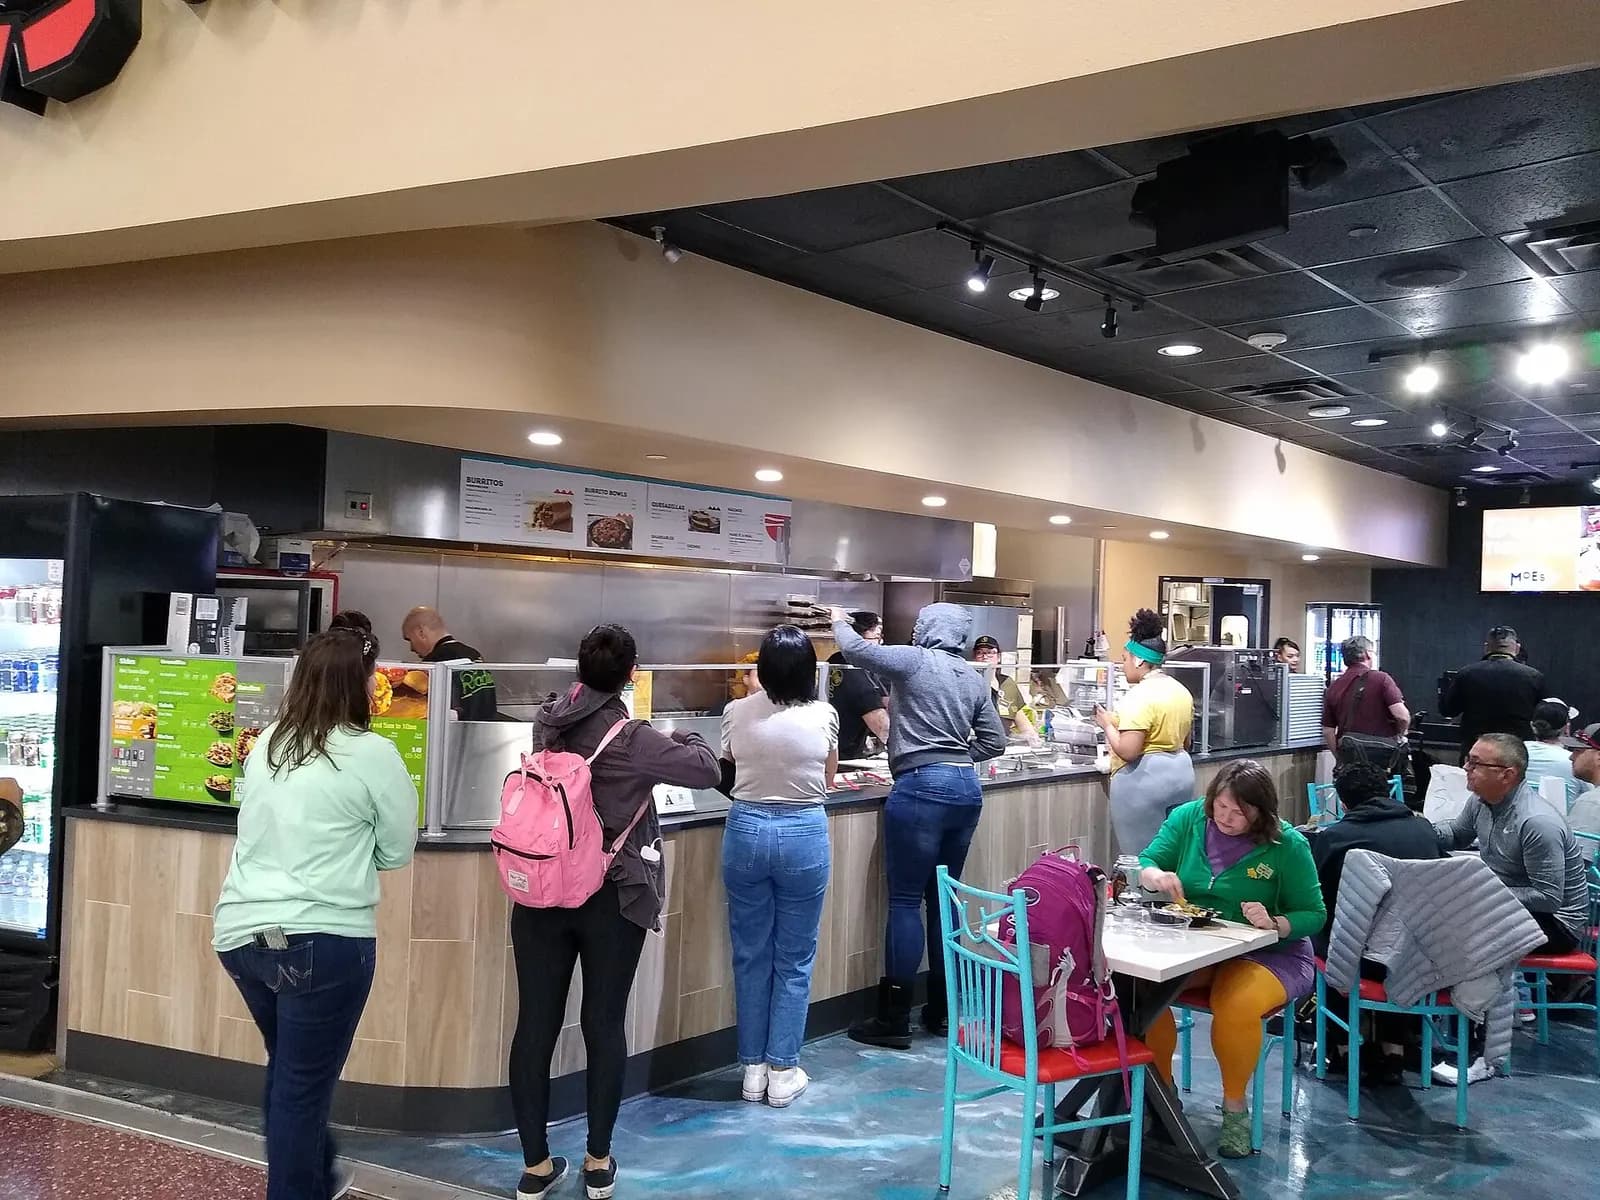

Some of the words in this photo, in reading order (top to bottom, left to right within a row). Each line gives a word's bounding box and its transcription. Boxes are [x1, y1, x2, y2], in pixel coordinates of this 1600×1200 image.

[466, 476, 504, 487] BURRITOS
[609, 489, 627, 497] BOWLS
[651, 501, 685, 510] QUESADILLAS
[665, 794, 674, 805] A
